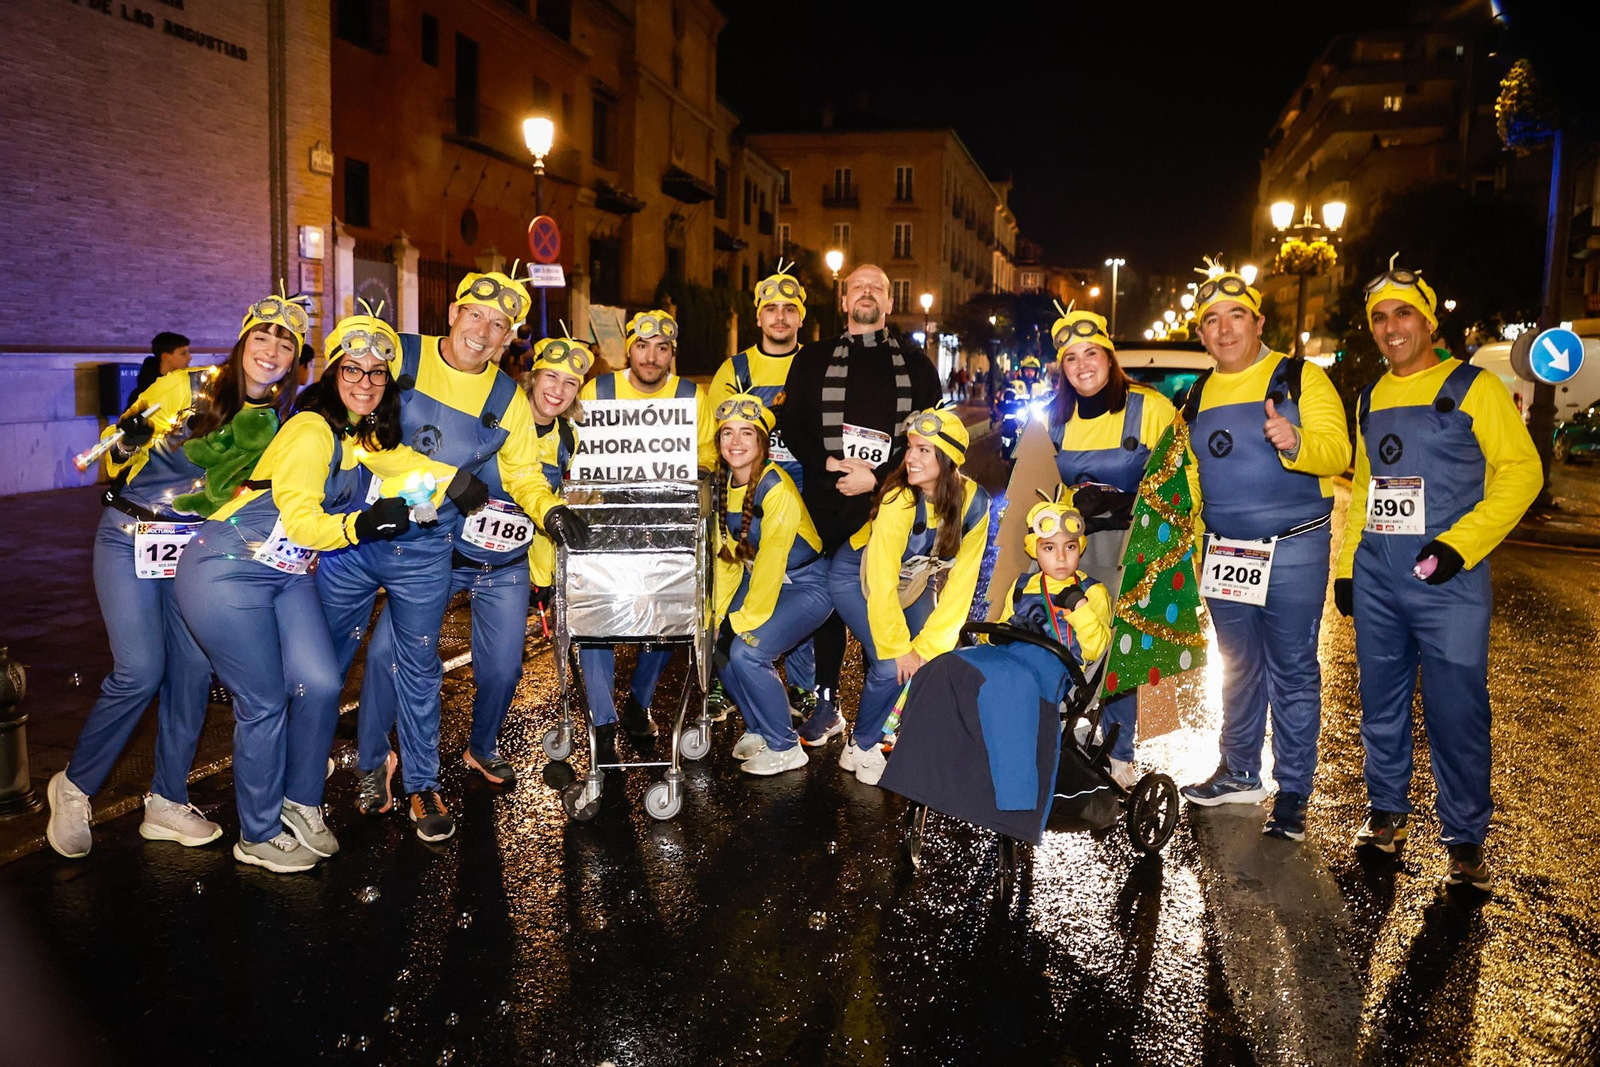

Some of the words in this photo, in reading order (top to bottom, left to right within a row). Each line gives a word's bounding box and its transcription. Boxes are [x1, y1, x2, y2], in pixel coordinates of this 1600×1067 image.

[121, 4, 154, 28] LAS
[163, 18, 247, 61] ANGUSTIAS
[575, 403, 694, 427] GRUMÓVIL
[576, 438, 647, 455] AHORA
[648, 437, 691, 453] CON
[842, 441, 882, 462] 168
[579, 466, 647, 480] BALIZA
[652, 462, 689, 479] V16
[1371, 499, 1415, 517] 590
[476, 516, 527, 541] 1188
[146, 544, 187, 561] 12
[1212, 563, 1262, 585] 1208
